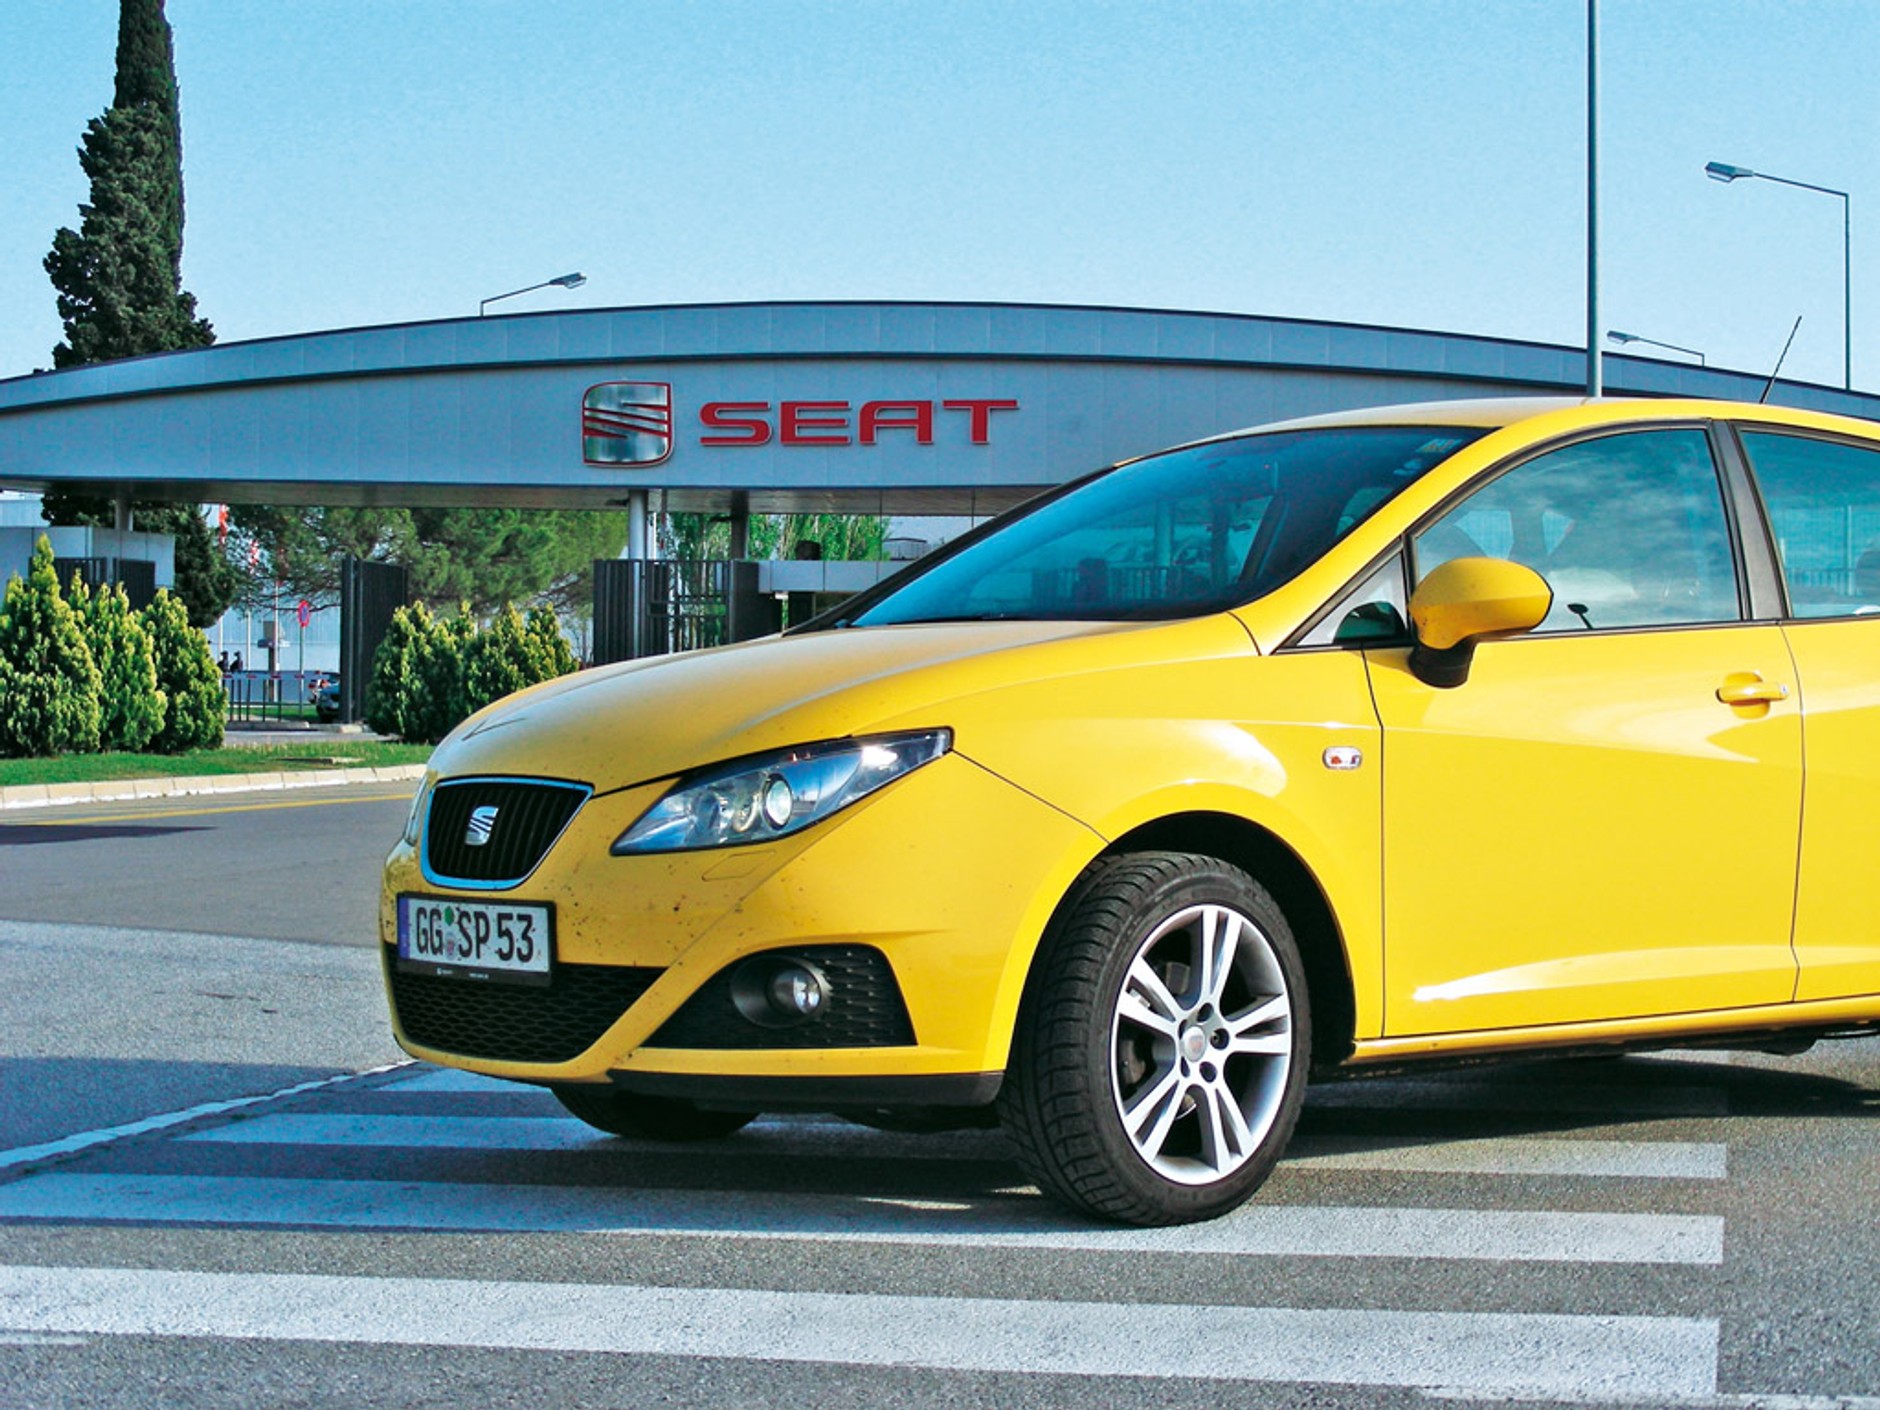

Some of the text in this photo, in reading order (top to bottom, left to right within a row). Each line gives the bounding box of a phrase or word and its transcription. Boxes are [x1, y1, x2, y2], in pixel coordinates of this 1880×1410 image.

[700, 399, 1018, 445] SEAT
[416, 906, 534, 963] GG SP 53
